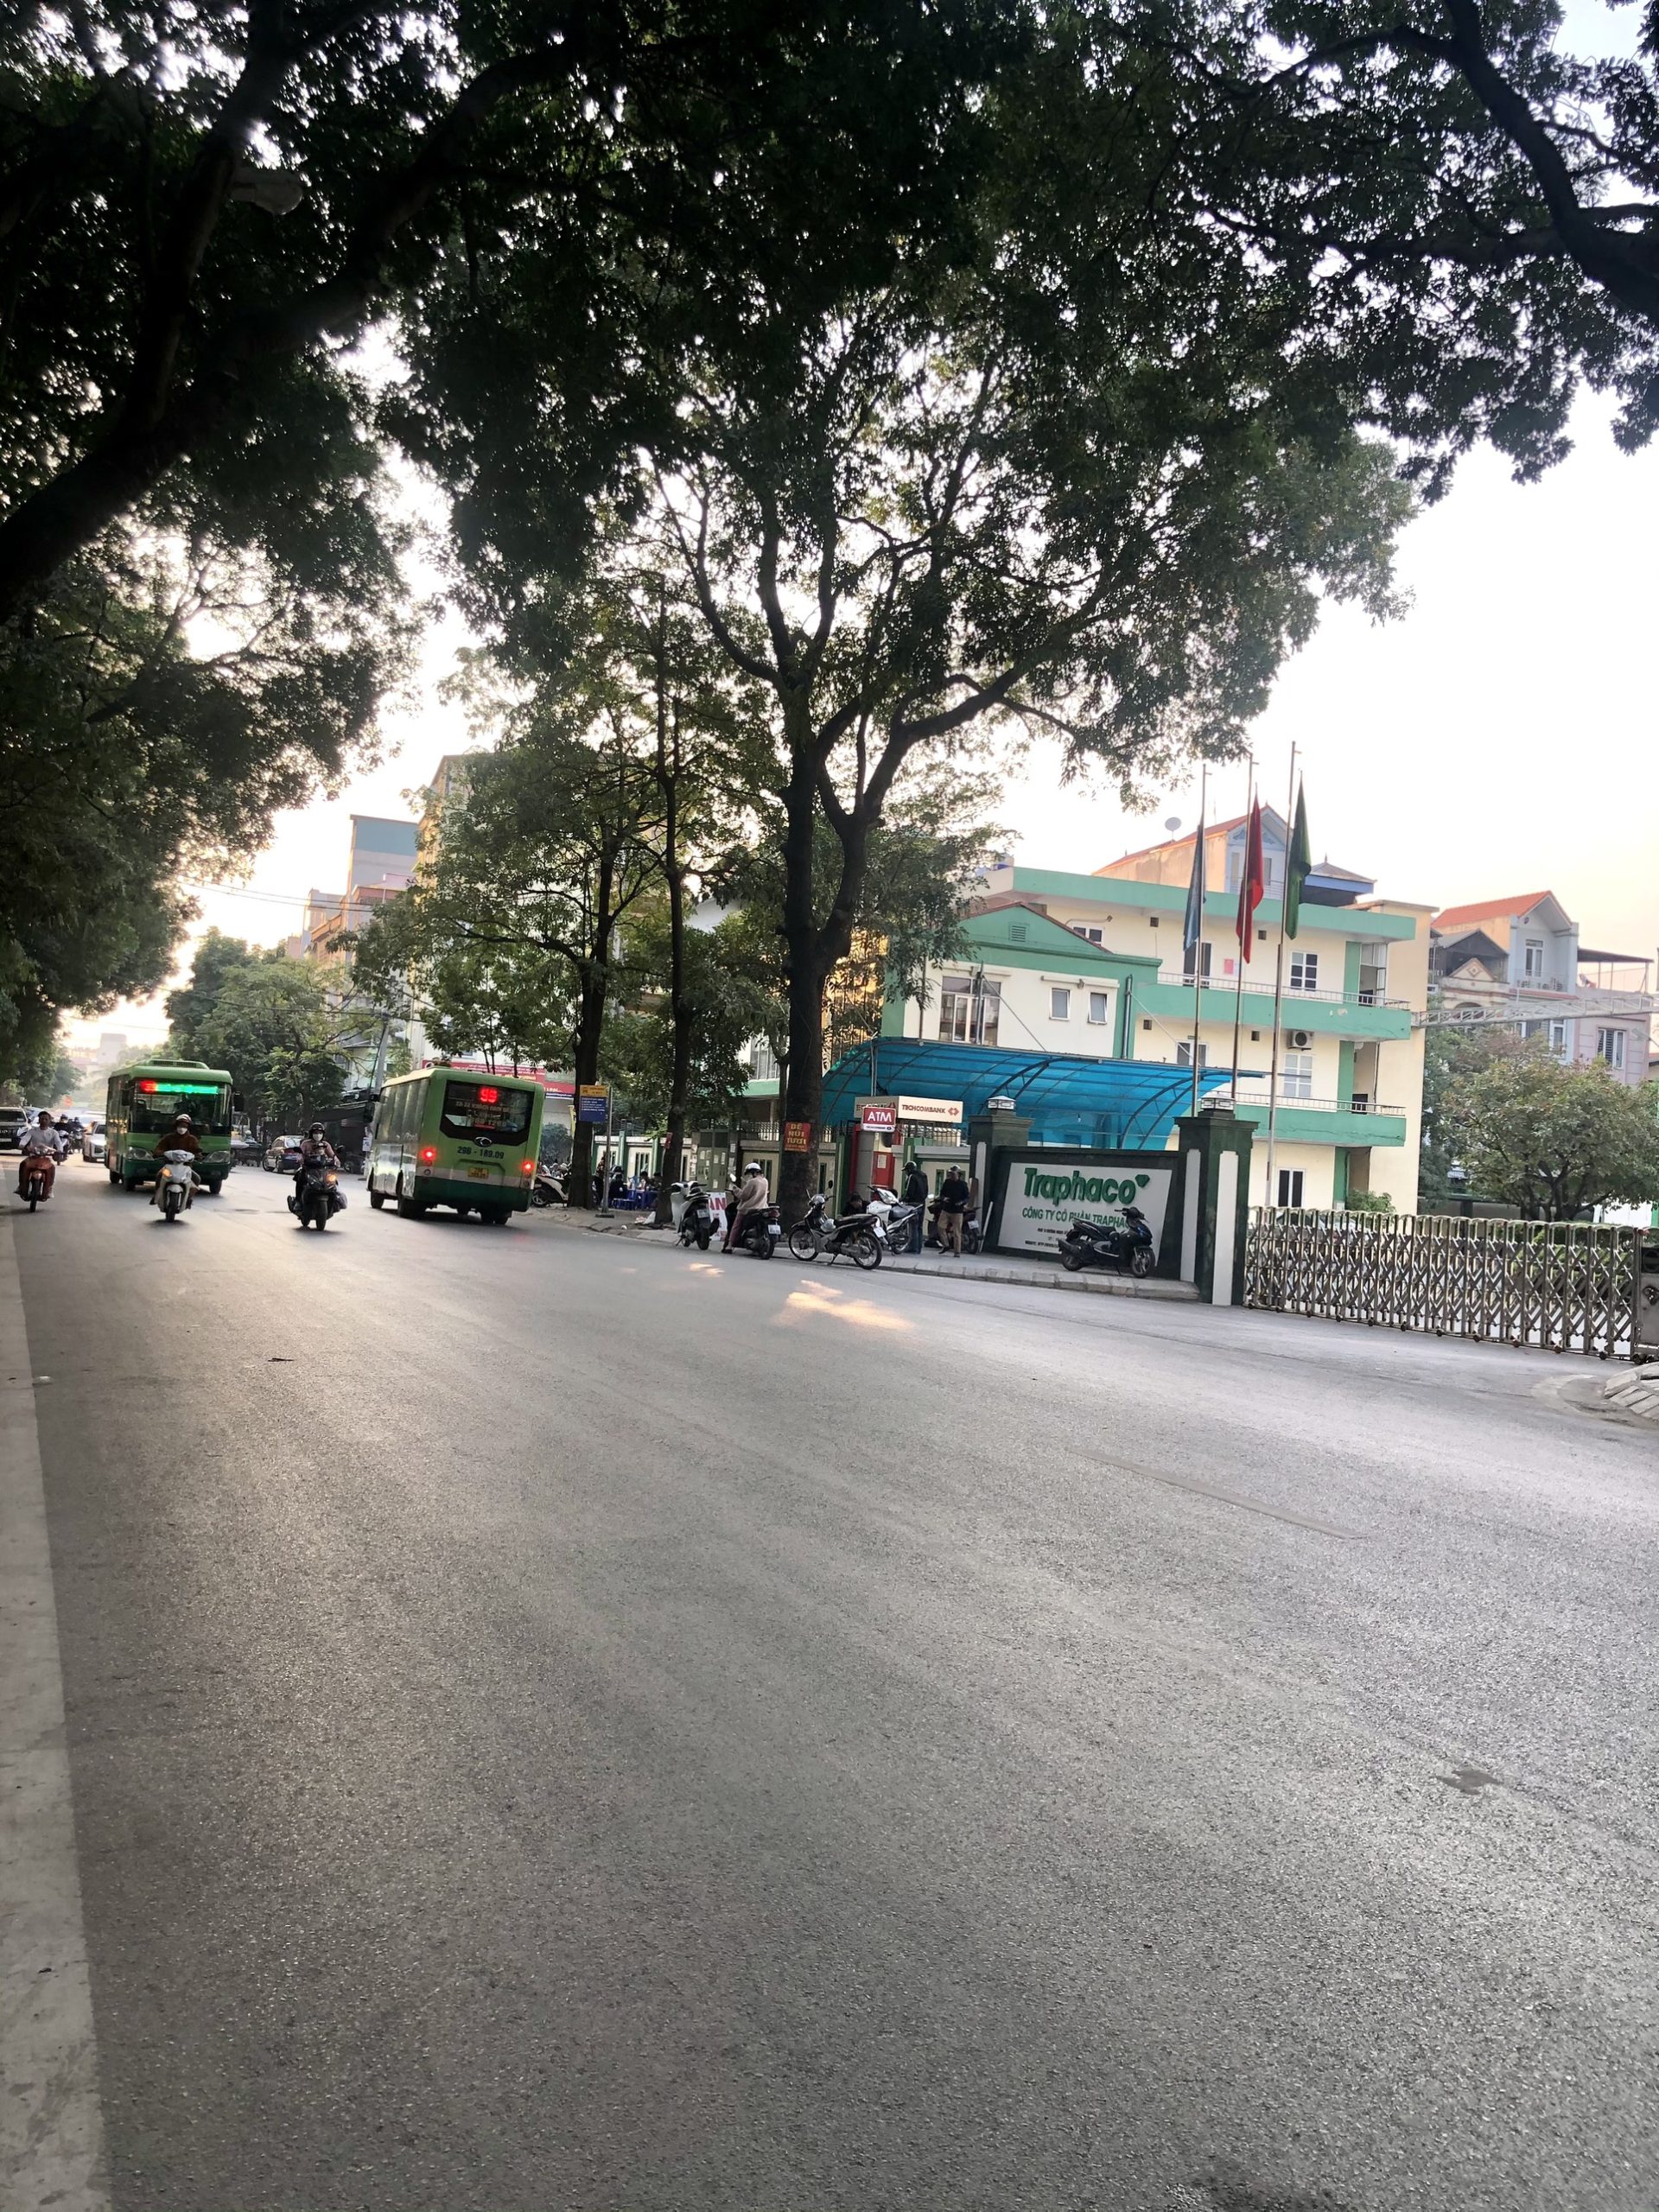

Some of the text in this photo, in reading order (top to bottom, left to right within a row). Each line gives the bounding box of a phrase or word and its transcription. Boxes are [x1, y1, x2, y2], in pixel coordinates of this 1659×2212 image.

[867, 1110, 893, 1122] ATM
[902, 1104, 946, 1114] TECHCOMBANK
[1024, 1167, 1136, 1206] Traphaco
[1022, 1205, 1044, 1220] CÔNG
[1046, 1210, 1055, 1221] TY
[1092, 1213, 1128, 1229] TRAPHA
